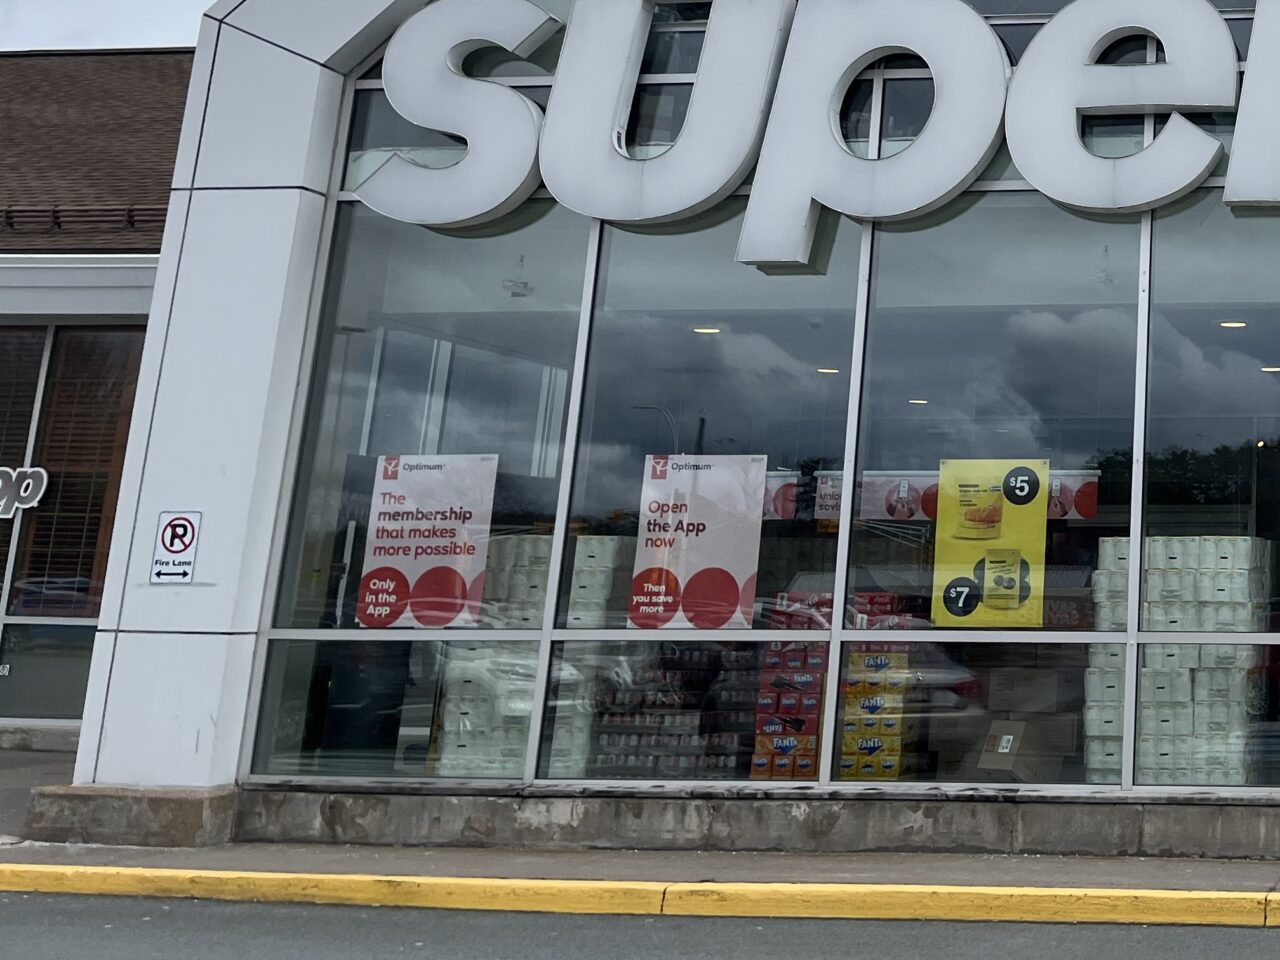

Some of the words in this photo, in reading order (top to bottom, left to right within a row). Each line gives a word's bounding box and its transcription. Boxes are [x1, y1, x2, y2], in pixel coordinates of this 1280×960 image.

[403, 463, 443, 472] Optimum
[671, 463, 712, 472] Optimum
[1009, 476, 1030, 497] $5
[381, 492, 406, 505] The
[378, 507, 473, 523] membership
[649, 501, 688, 517] Open
[376, 526, 405, 539] that
[408, 526, 457, 539] makes
[647, 520, 672, 532] the
[674, 520, 707, 537] App
[645, 537, 675, 548] now
[373, 545, 411, 557] more
[414, 542, 476, 560] possible
[172, 559, 192, 567] Lane
[370, 578, 396, 592] Only
[643, 583, 666, 592] Then
[365, 592, 376, 603] in
[378, 592, 397, 603] the
[632, 595, 650, 605] you
[651, 595, 673, 603] save
[950, 587, 970, 608] $7
[366, 604, 391, 618] App
[640, 605, 664, 613] more
[773, 736, 798, 749] FANTA
[857, 737, 883, 749] FANTA
